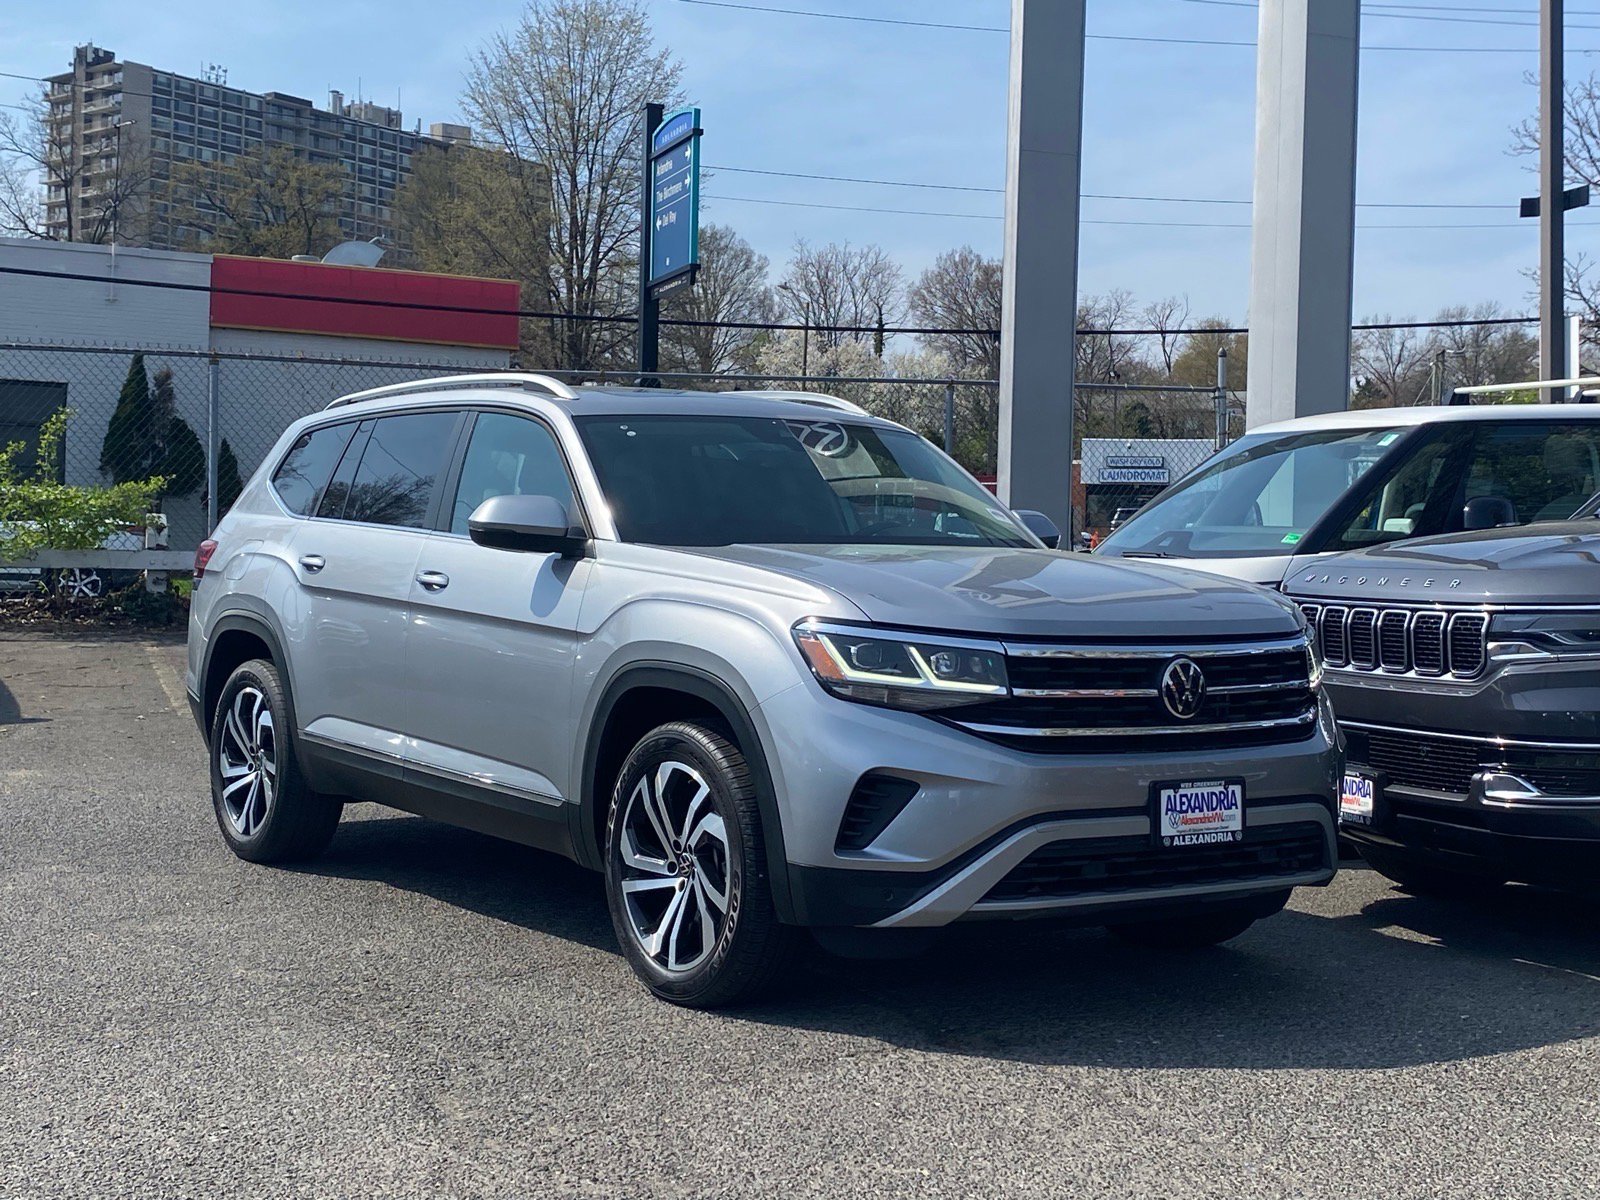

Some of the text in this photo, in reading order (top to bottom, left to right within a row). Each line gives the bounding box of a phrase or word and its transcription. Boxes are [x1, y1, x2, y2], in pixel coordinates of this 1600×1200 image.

[669, 211, 677, 225] Ray
[1101, 471, 1167, 481] LAUNDROMAT
[1304, 574, 1462, 589] WAGONEER
[1165, 789, 1239, 816] ALEXANDRIA
[1173, 831, 1233, 846] ALEXANDRIA
